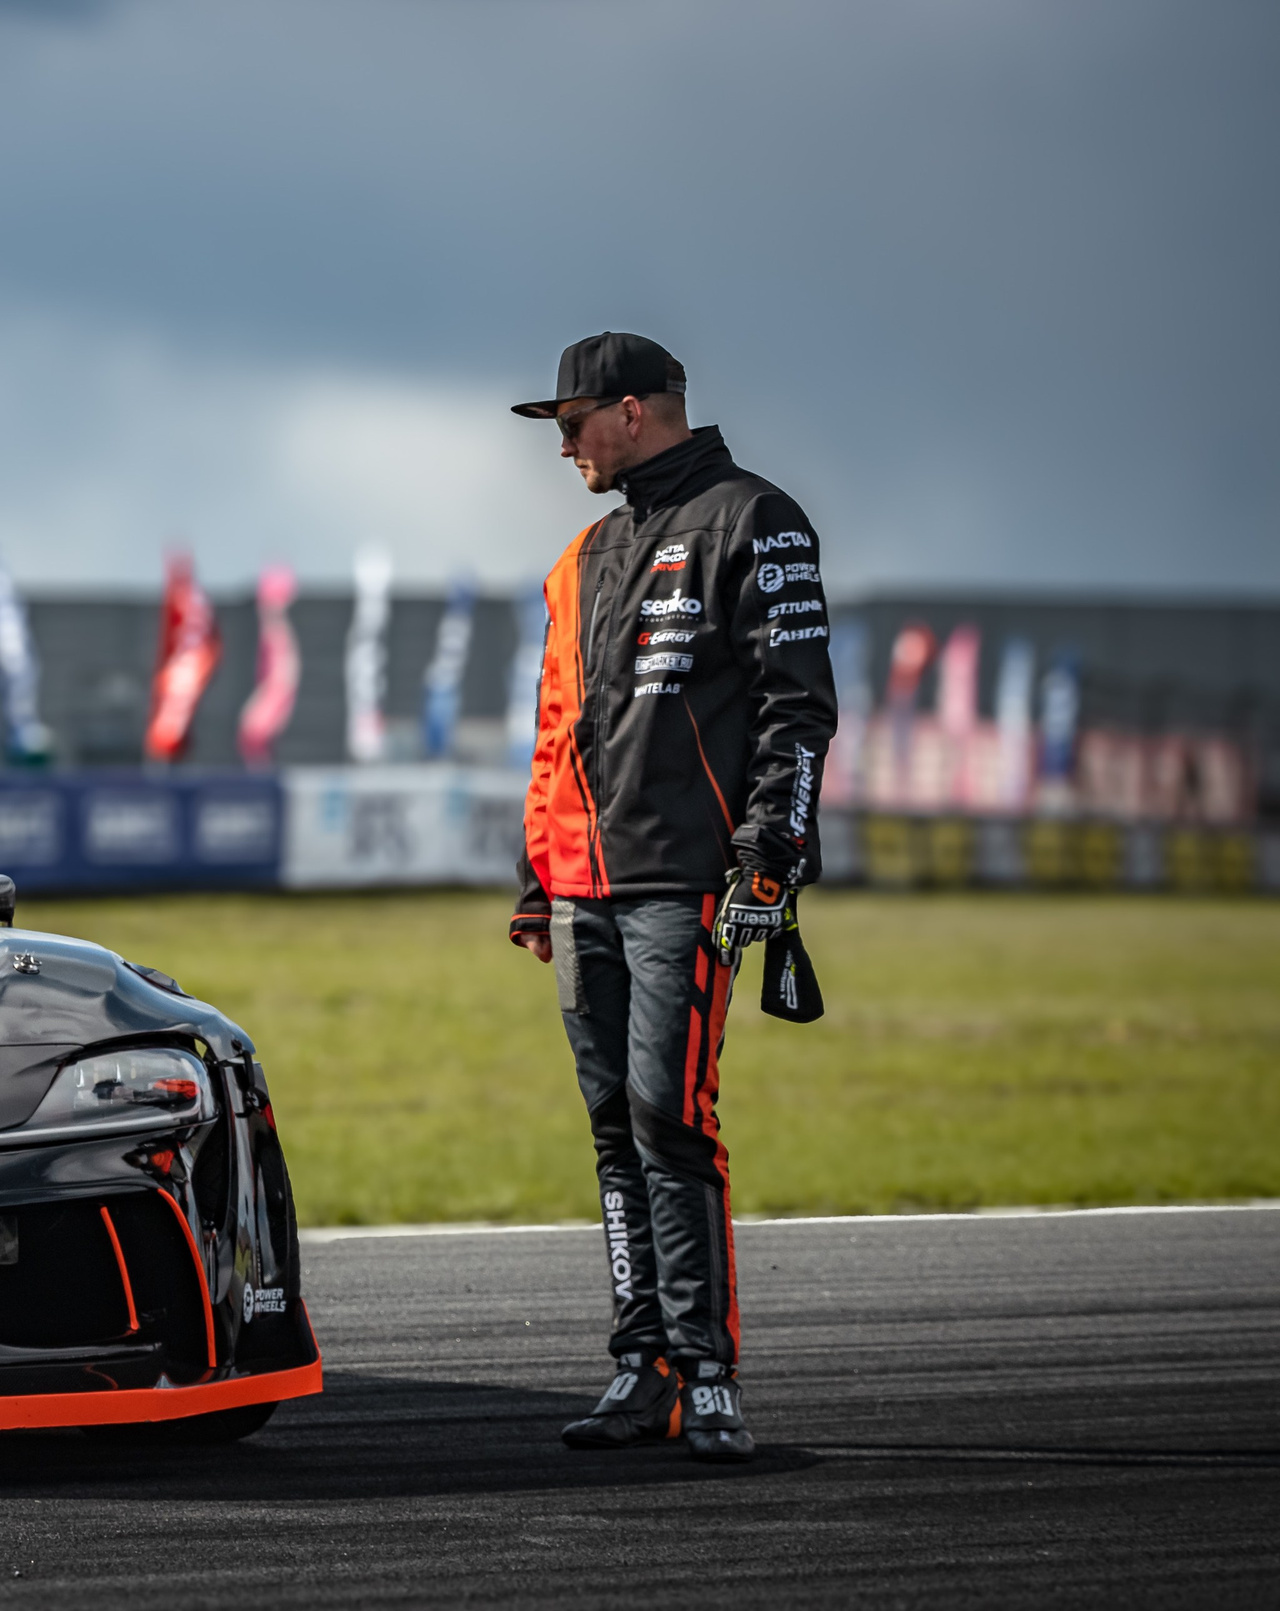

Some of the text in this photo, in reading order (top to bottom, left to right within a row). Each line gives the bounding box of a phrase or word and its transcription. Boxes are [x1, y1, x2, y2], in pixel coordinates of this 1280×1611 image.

[728, 910, 782, 928] freem
[604, 1190, 634, 1301] SHIKOV
[255, 1288, 284, 1301] POWER
[255, 1300, 287, 1312] WHEELS
[692, 1385, 734, 1417] 90
